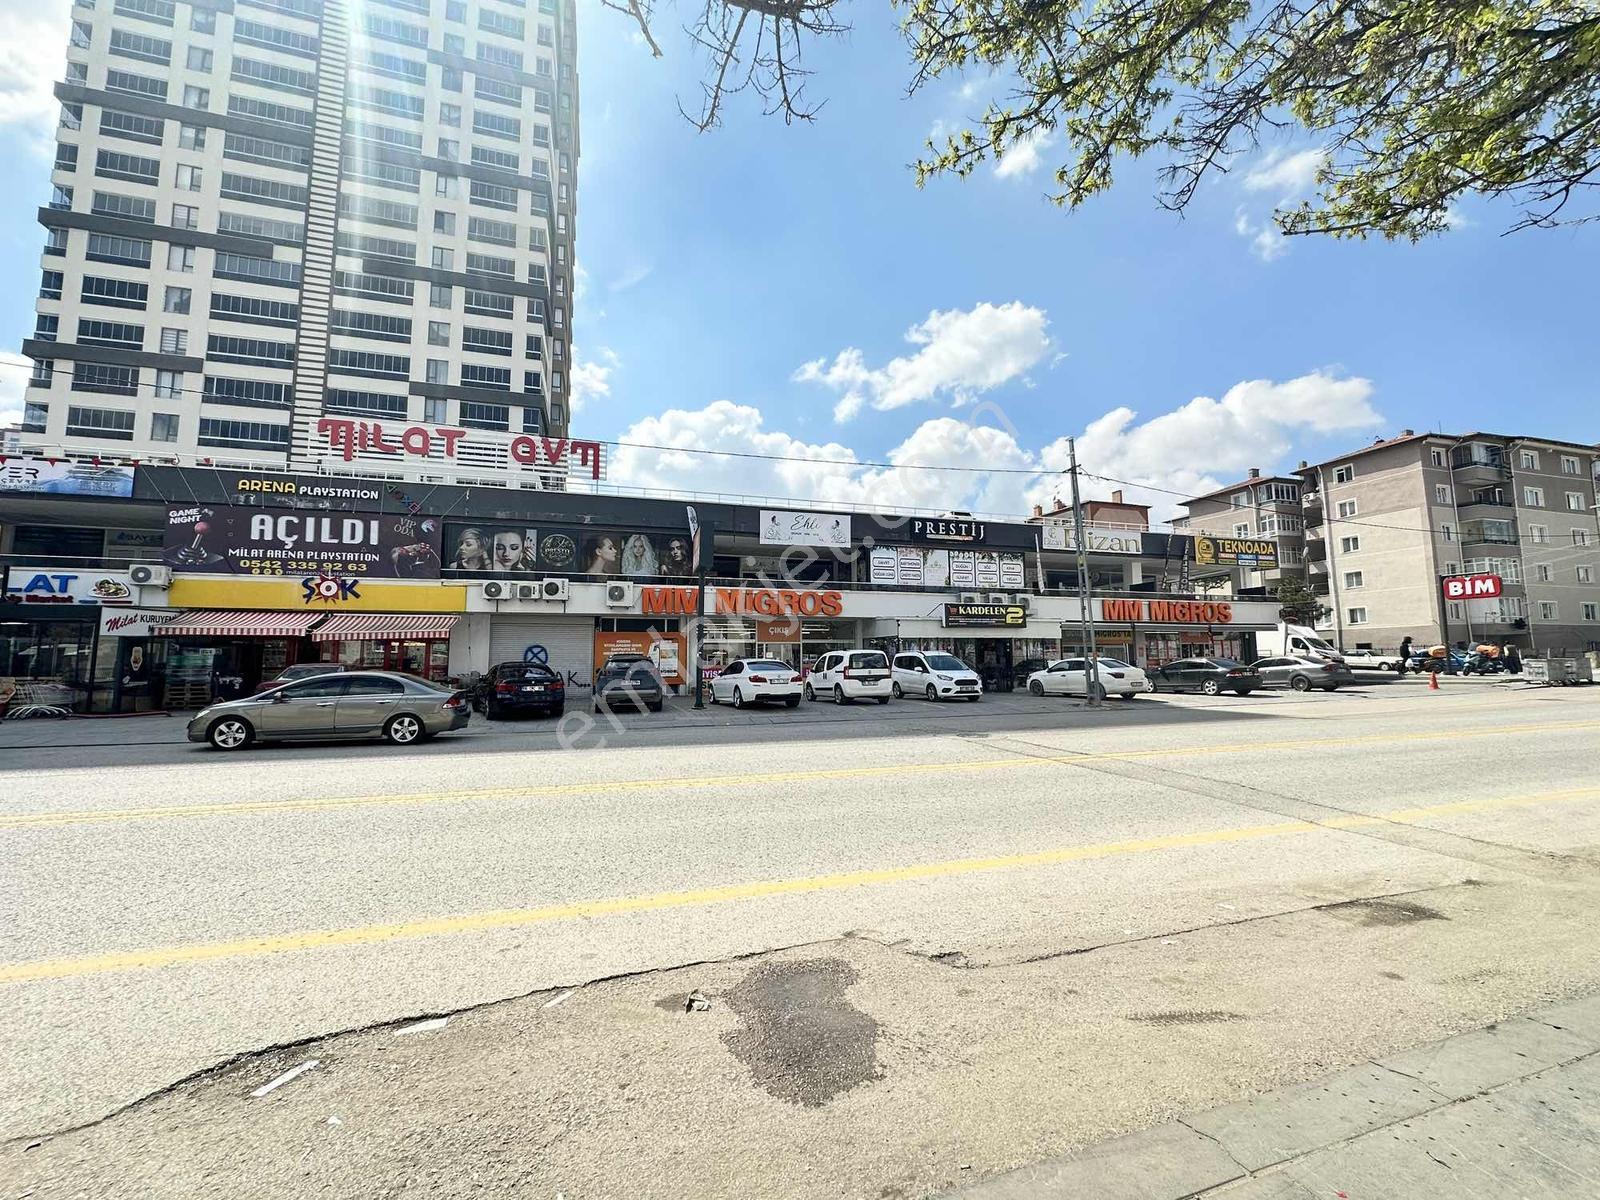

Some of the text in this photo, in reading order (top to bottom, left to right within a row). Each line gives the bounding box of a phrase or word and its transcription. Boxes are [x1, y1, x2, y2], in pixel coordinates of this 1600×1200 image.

[238, 479, 379, 500] ARENA PLAYSTATION
[169, 508, 200, 517] GAME
[169, 515, 202, 524] NIGHT
[250, 514, 380, 549] AÇILDI
[393, 524, 415, 537] ODA
[400, 517, 416, 529] VIP
[914, 521, 985, 540] PRESTİJ
[267, 549, 304, 559] ARENA
[1217, 540, 1275, 555] TEKNOADA
[240, 559, 282, 569] 0542
[287, 561, 318, 570] 335
[347, 563, 367, 571] 63
[1448, 577, 1495, 596] BİM
[641, 587, 699, 616] MM
[1102, 599, 1143, 621] MM
[105, 613, 138, 632] Milat
[959, 606, 1006, 614] KARDELEN
[1006, 607, 1024, 623] 2
